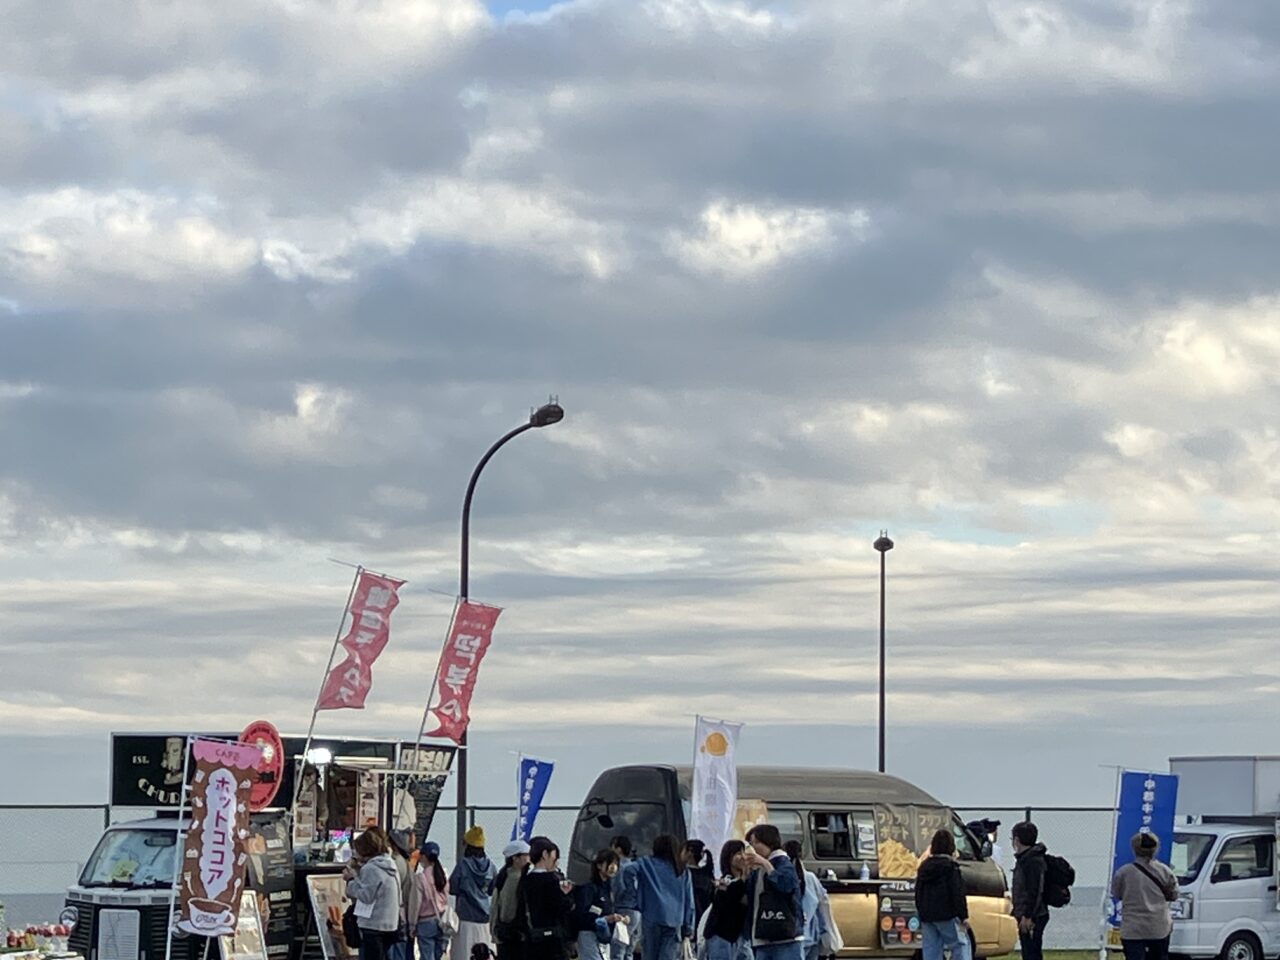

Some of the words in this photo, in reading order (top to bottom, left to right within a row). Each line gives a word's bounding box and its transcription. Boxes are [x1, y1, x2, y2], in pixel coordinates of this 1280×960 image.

[138, 778, 182, 804] CHUR
[207, 777, 231, 885] ホットココア
[761, 911, 786, 920] A.P.C.
